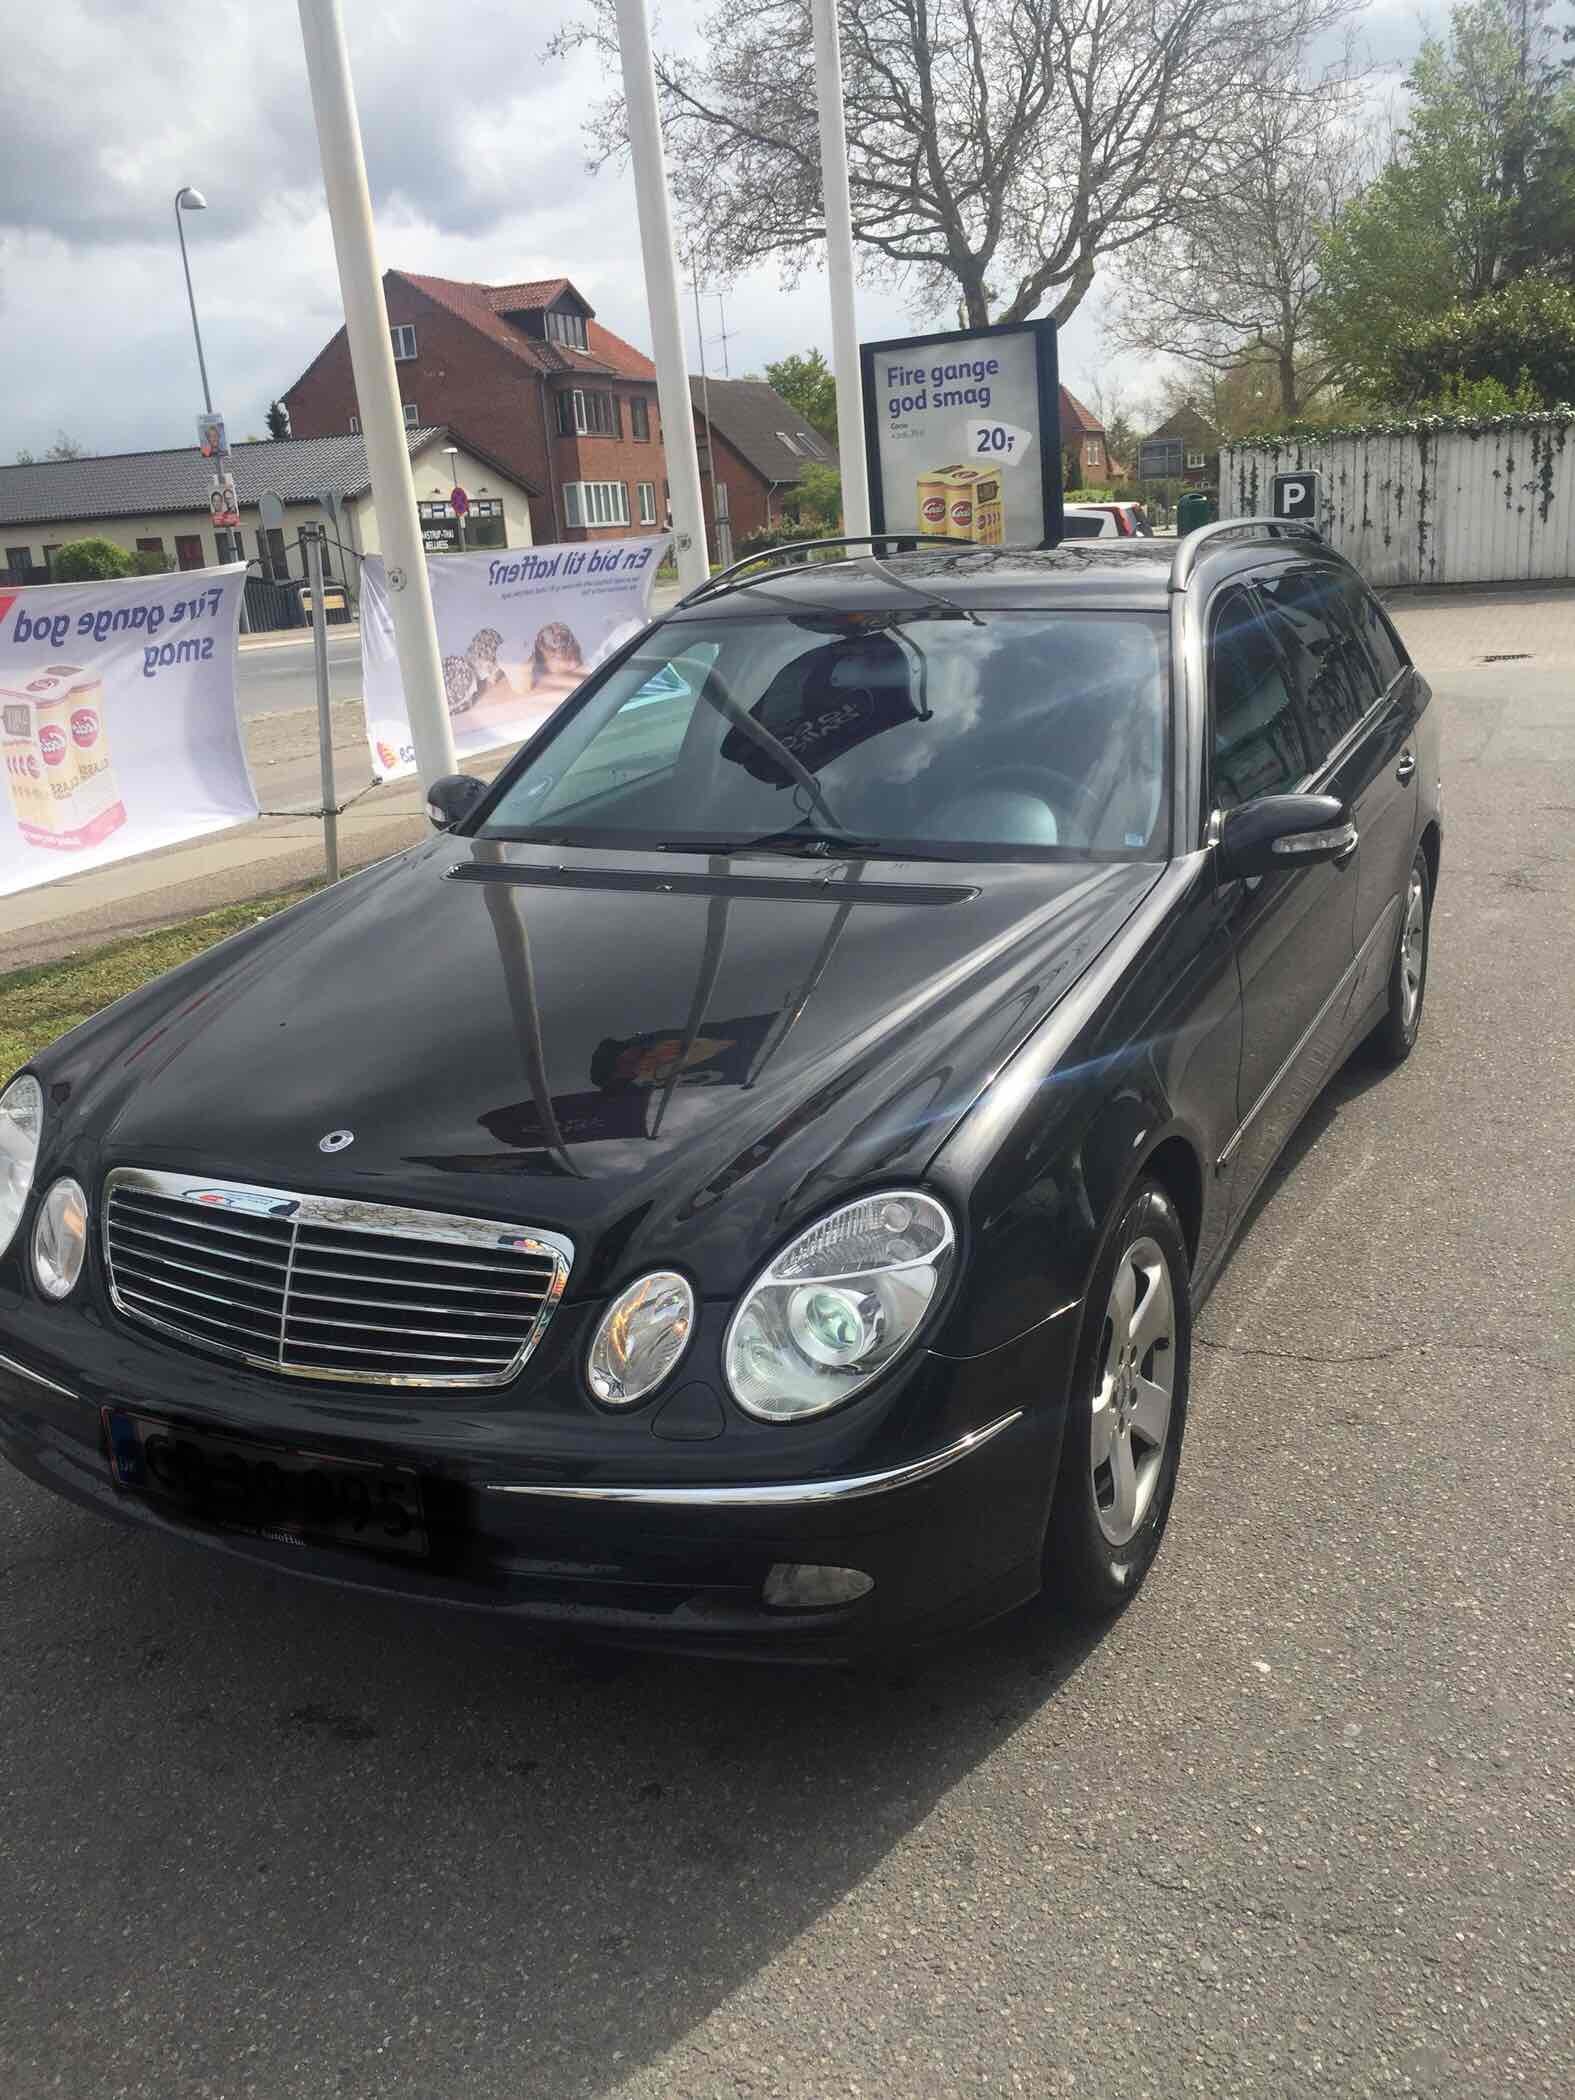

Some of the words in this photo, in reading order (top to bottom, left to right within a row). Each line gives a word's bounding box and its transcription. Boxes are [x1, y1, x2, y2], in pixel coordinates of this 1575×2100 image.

[887, 366, 925, 388] Fire
[931, 359, 999, 387] gange
[889, 389, 927, 418] god
[932, 387, 991, 408] smag
[1283, 482, 1306, 514] P
